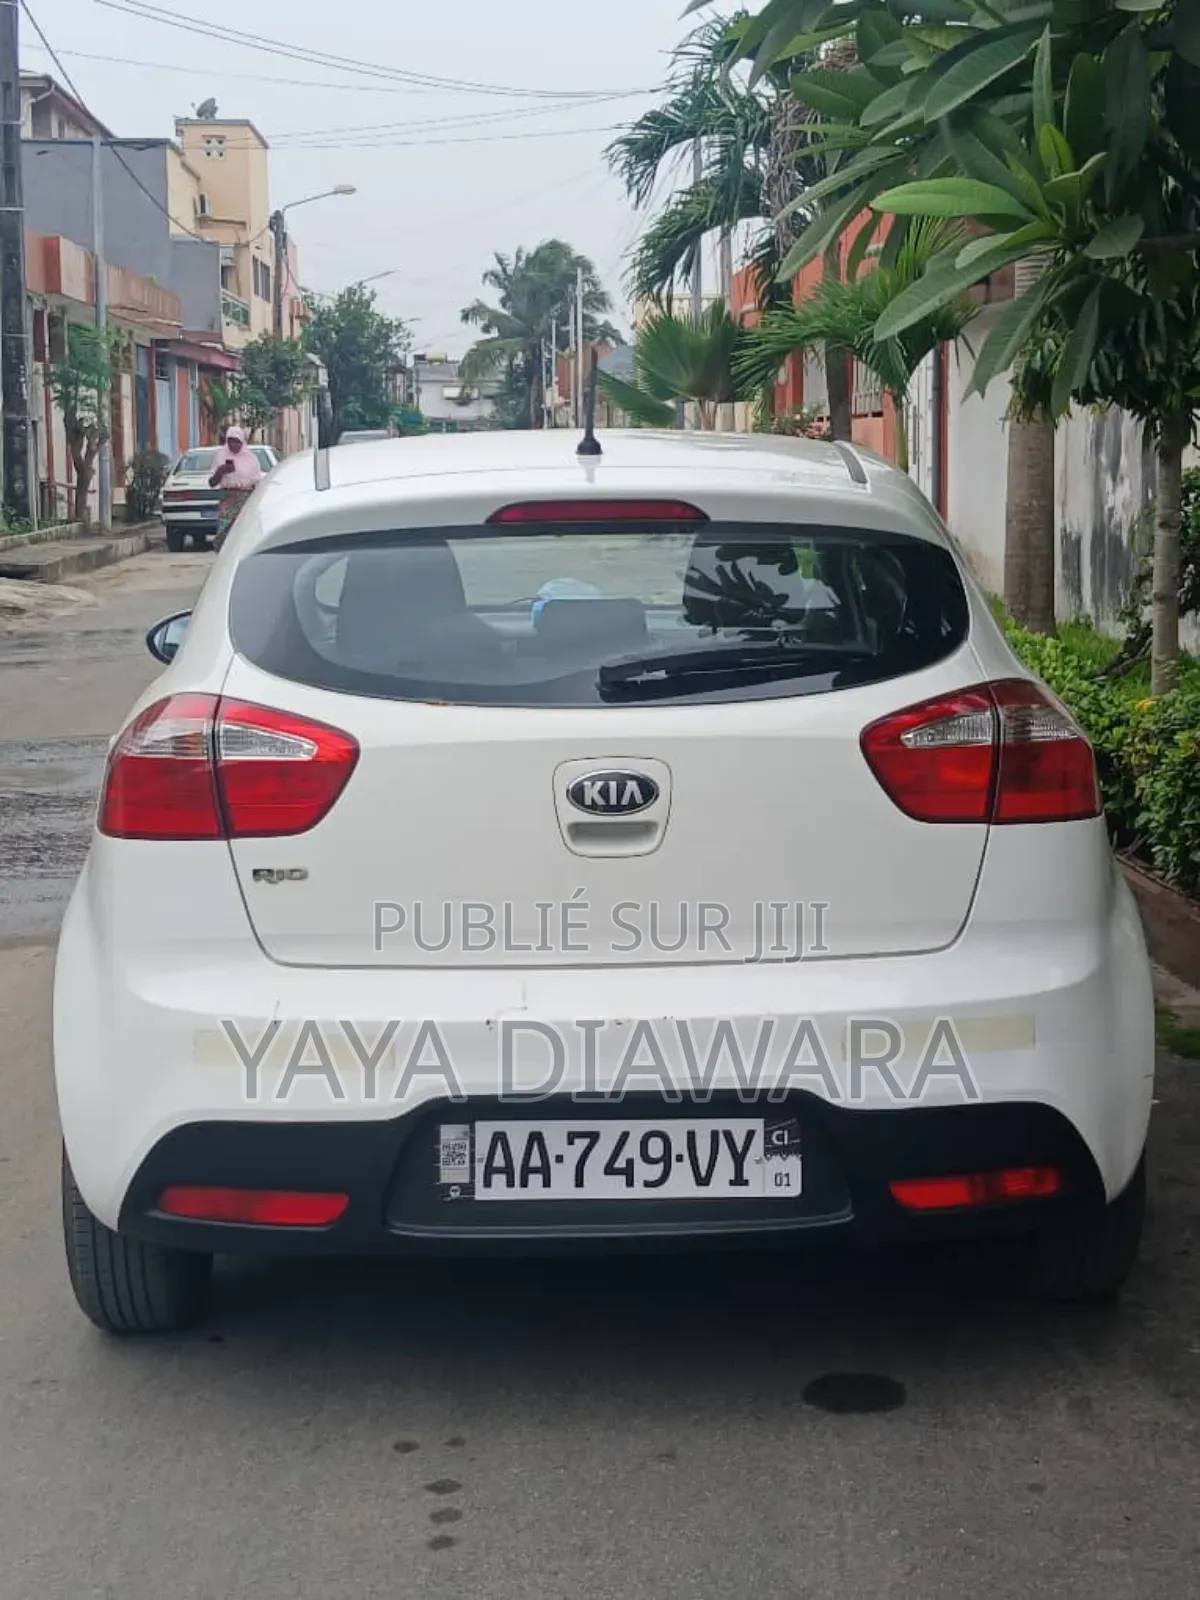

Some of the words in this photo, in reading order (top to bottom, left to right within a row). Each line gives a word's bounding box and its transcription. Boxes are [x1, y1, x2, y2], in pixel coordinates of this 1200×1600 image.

[582, 780, 644, 806] KIA
[252, 868, 309, 885] RIO
[771, 1130, 789, 1146] CI
[774, 1172, 791, 1187] 01
